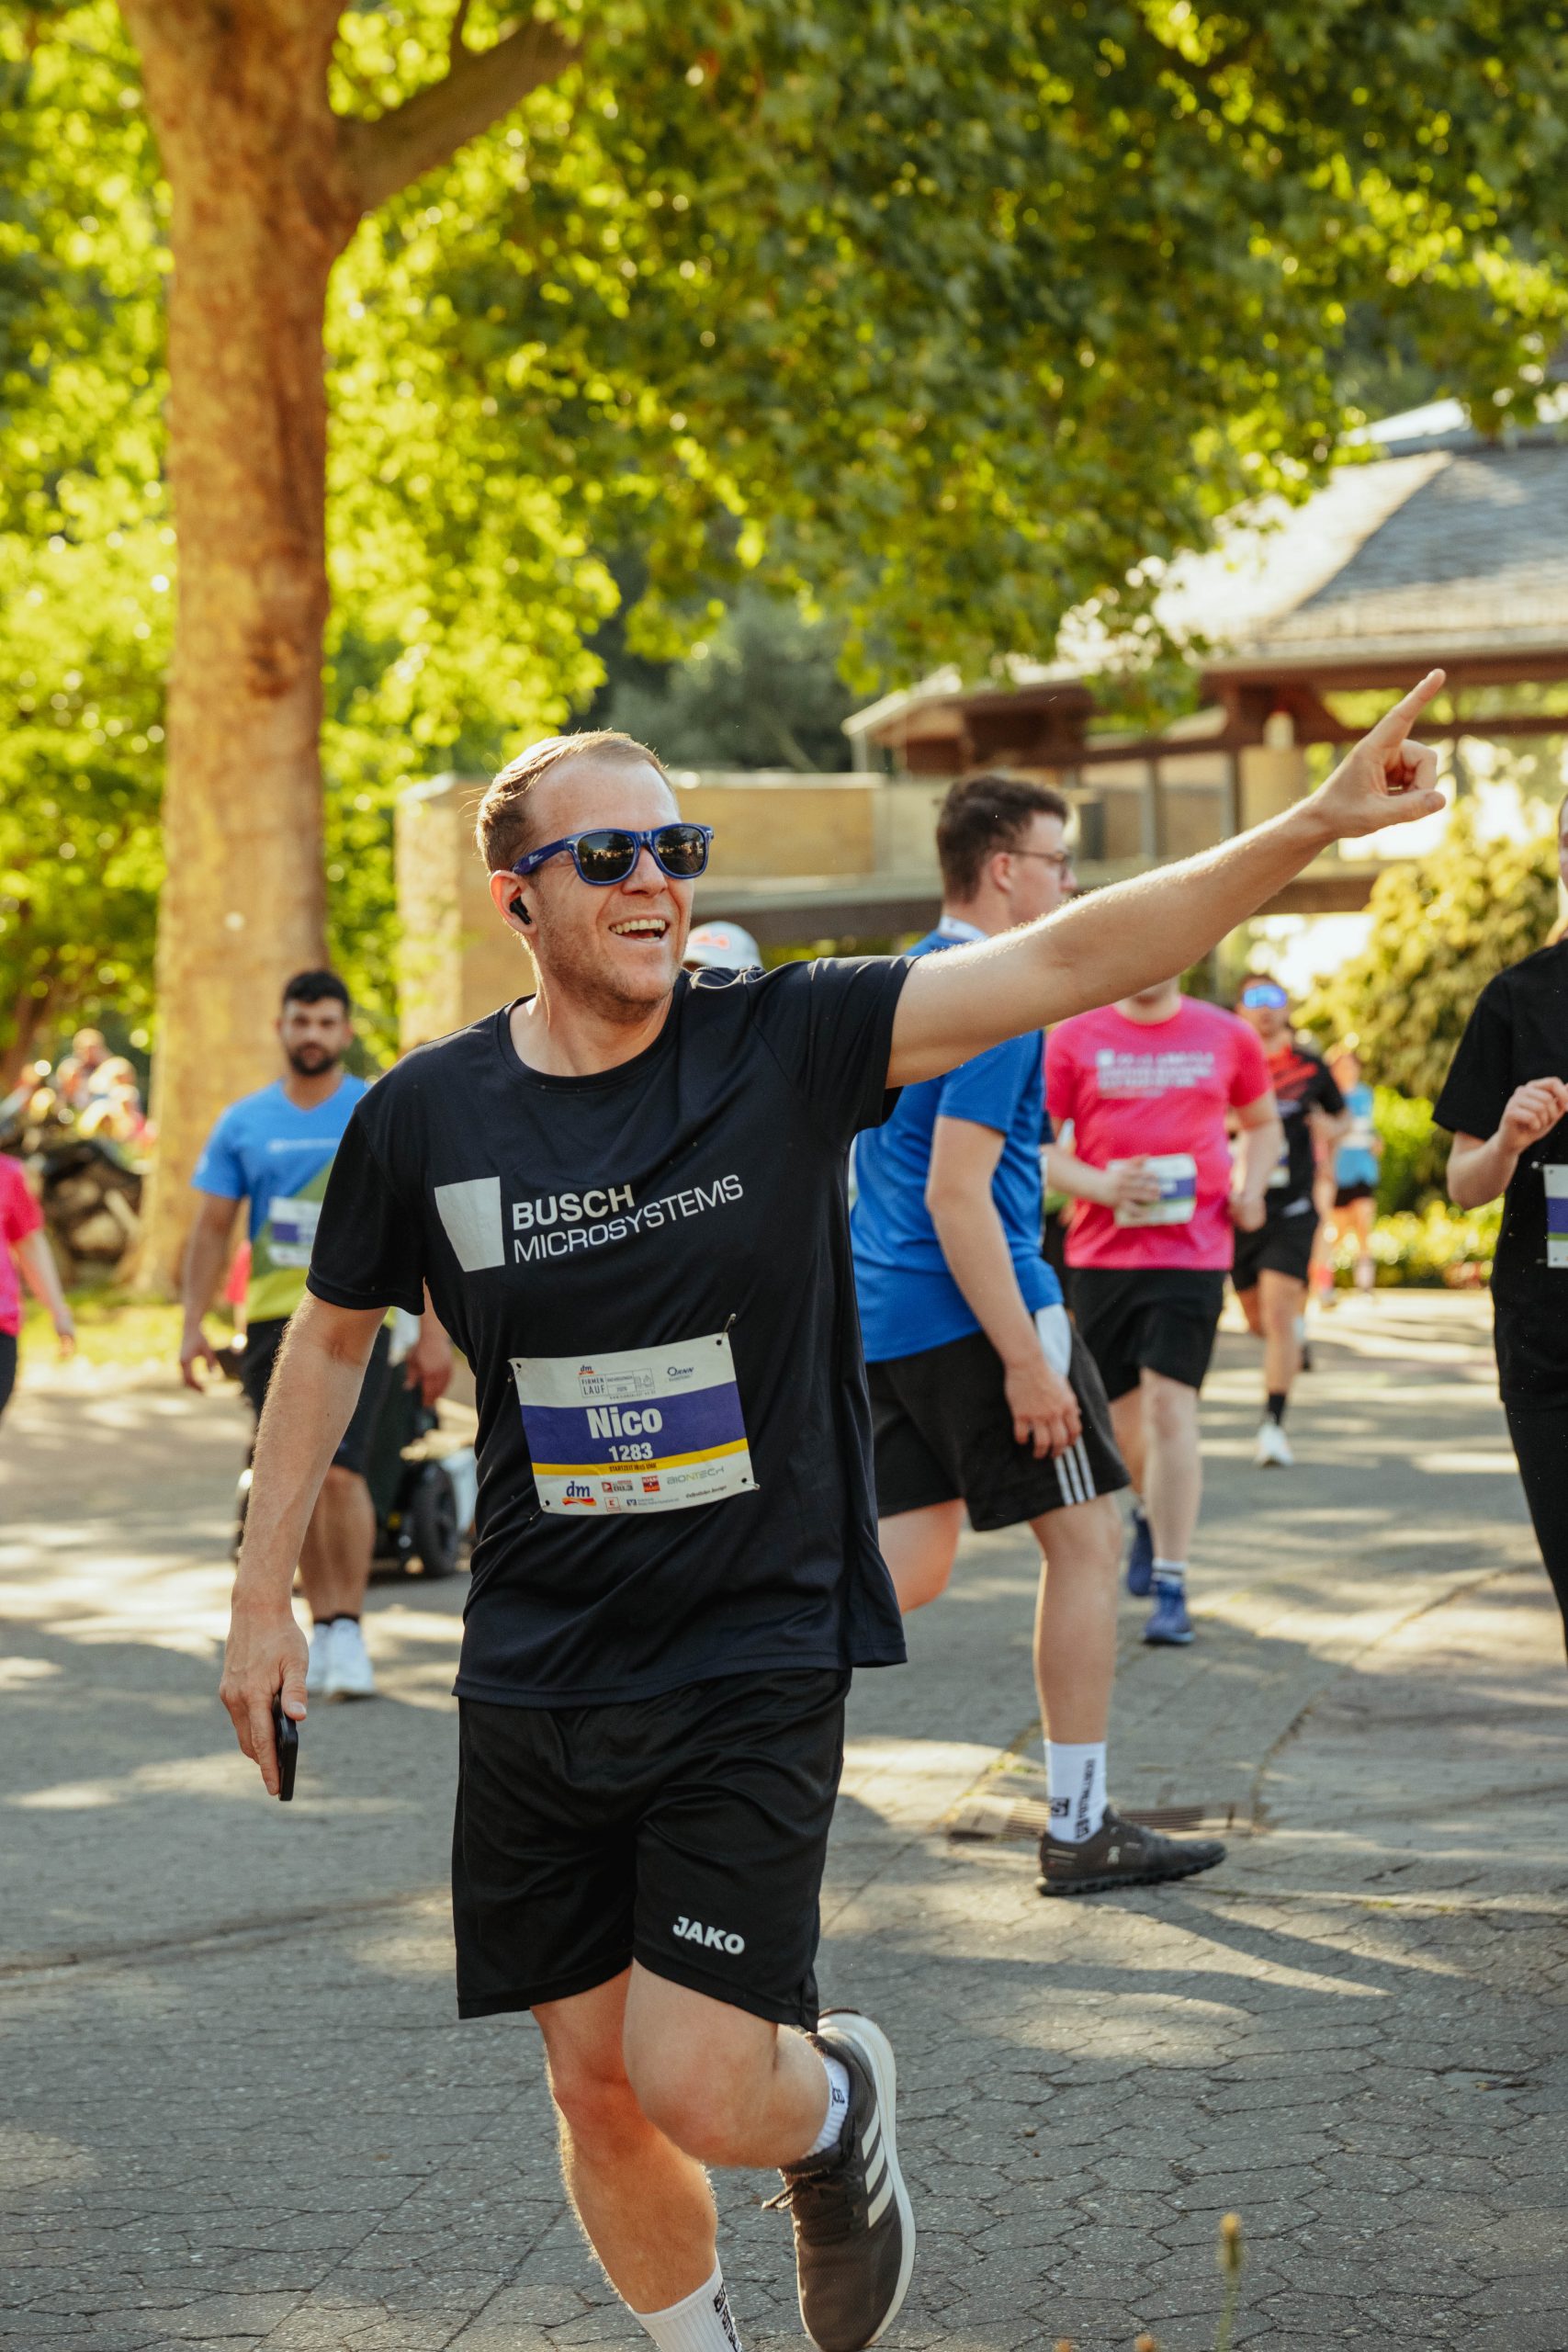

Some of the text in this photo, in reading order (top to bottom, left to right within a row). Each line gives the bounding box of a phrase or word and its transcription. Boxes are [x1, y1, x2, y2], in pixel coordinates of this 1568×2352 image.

[512, 1184, 635, 1230] BUSCH
[513, 1174, 743, 1263] MICROSYSTEMS
[581, 1376, 605, 1385] FIRMEN
[583, 1385, 605, 1396] LAUF
[586, 1406, 663, 1440] Nico
[608, 1442, 654, 1462] 1283
[667, 1465, 724, 1486] BIONTECH
[566, 1480, 591, 1498] dm
[672, 1916, 746, 1955] JAKO
